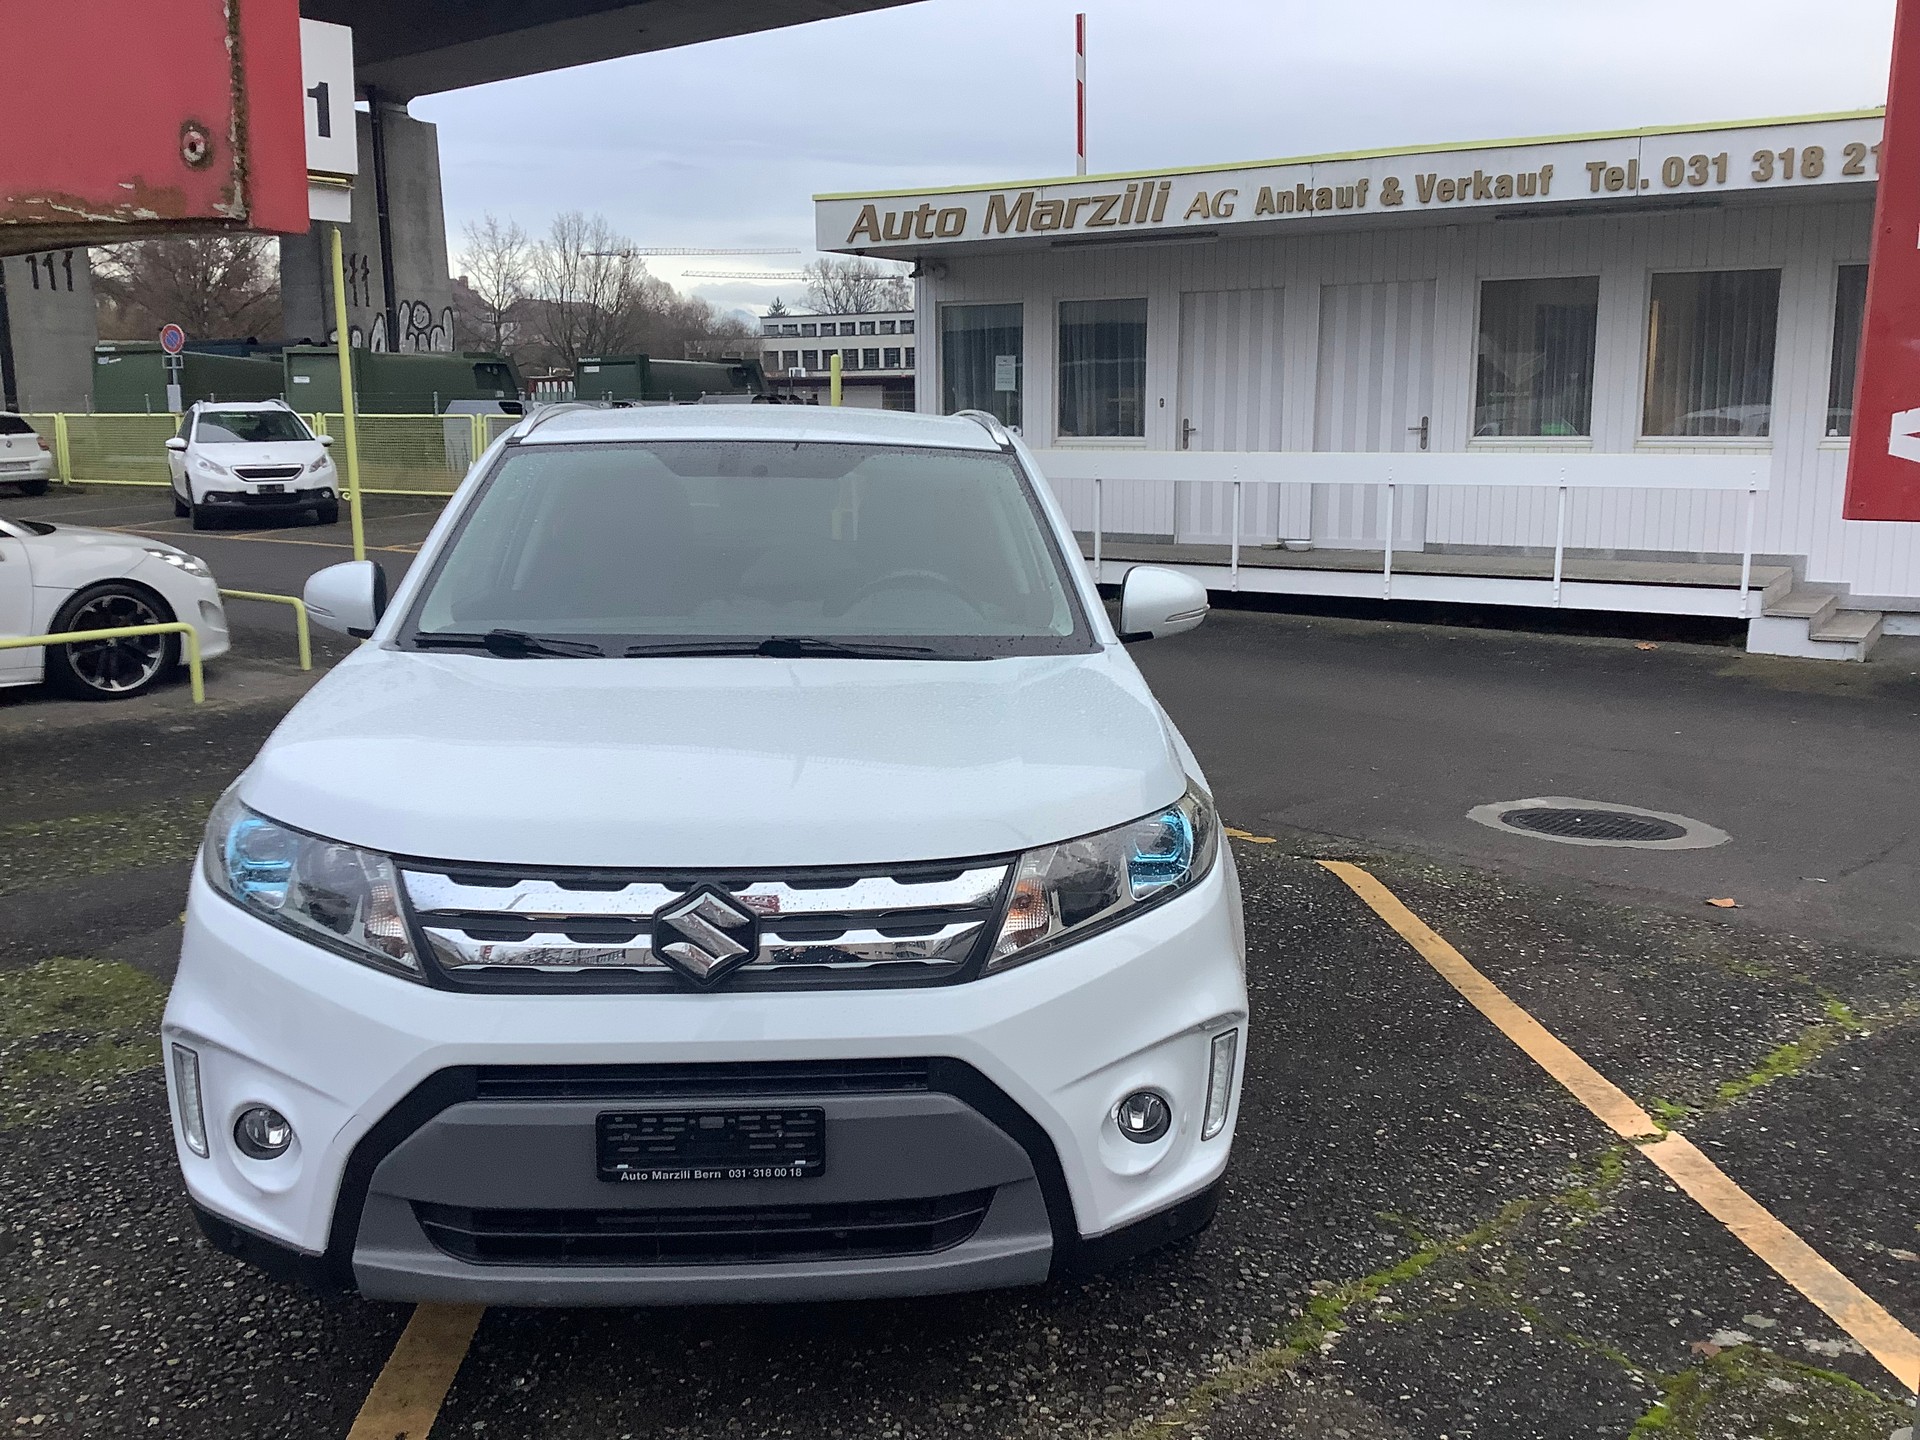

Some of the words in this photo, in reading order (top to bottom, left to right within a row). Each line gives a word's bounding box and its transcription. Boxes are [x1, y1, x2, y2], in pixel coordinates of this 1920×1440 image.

[307, 81, 331, 138] 1
[846, 202, 968, 244] Auto
[982, 180, 1172, 234] Marzili
[1183, 188, 1238, 220] AG
[1254, 177, 1369, 215] Ankauf
[1380, 176, 1404, 206] &
[1414, 164, 1554, 203] Verkauf
[1585, 158, 1649, 192] Tel.
[1661, 152, 1728, 188] 031
[1751, 145, 1824, 183] 318
[620, 1171, 648, 1181] Auto
[651, 1169, 690, 1180] Marzili
[694, 1169, 722, 1179] Bern
[774, 1167, 787, 1177] 00
[789, 1167, 802, 1177] 18
